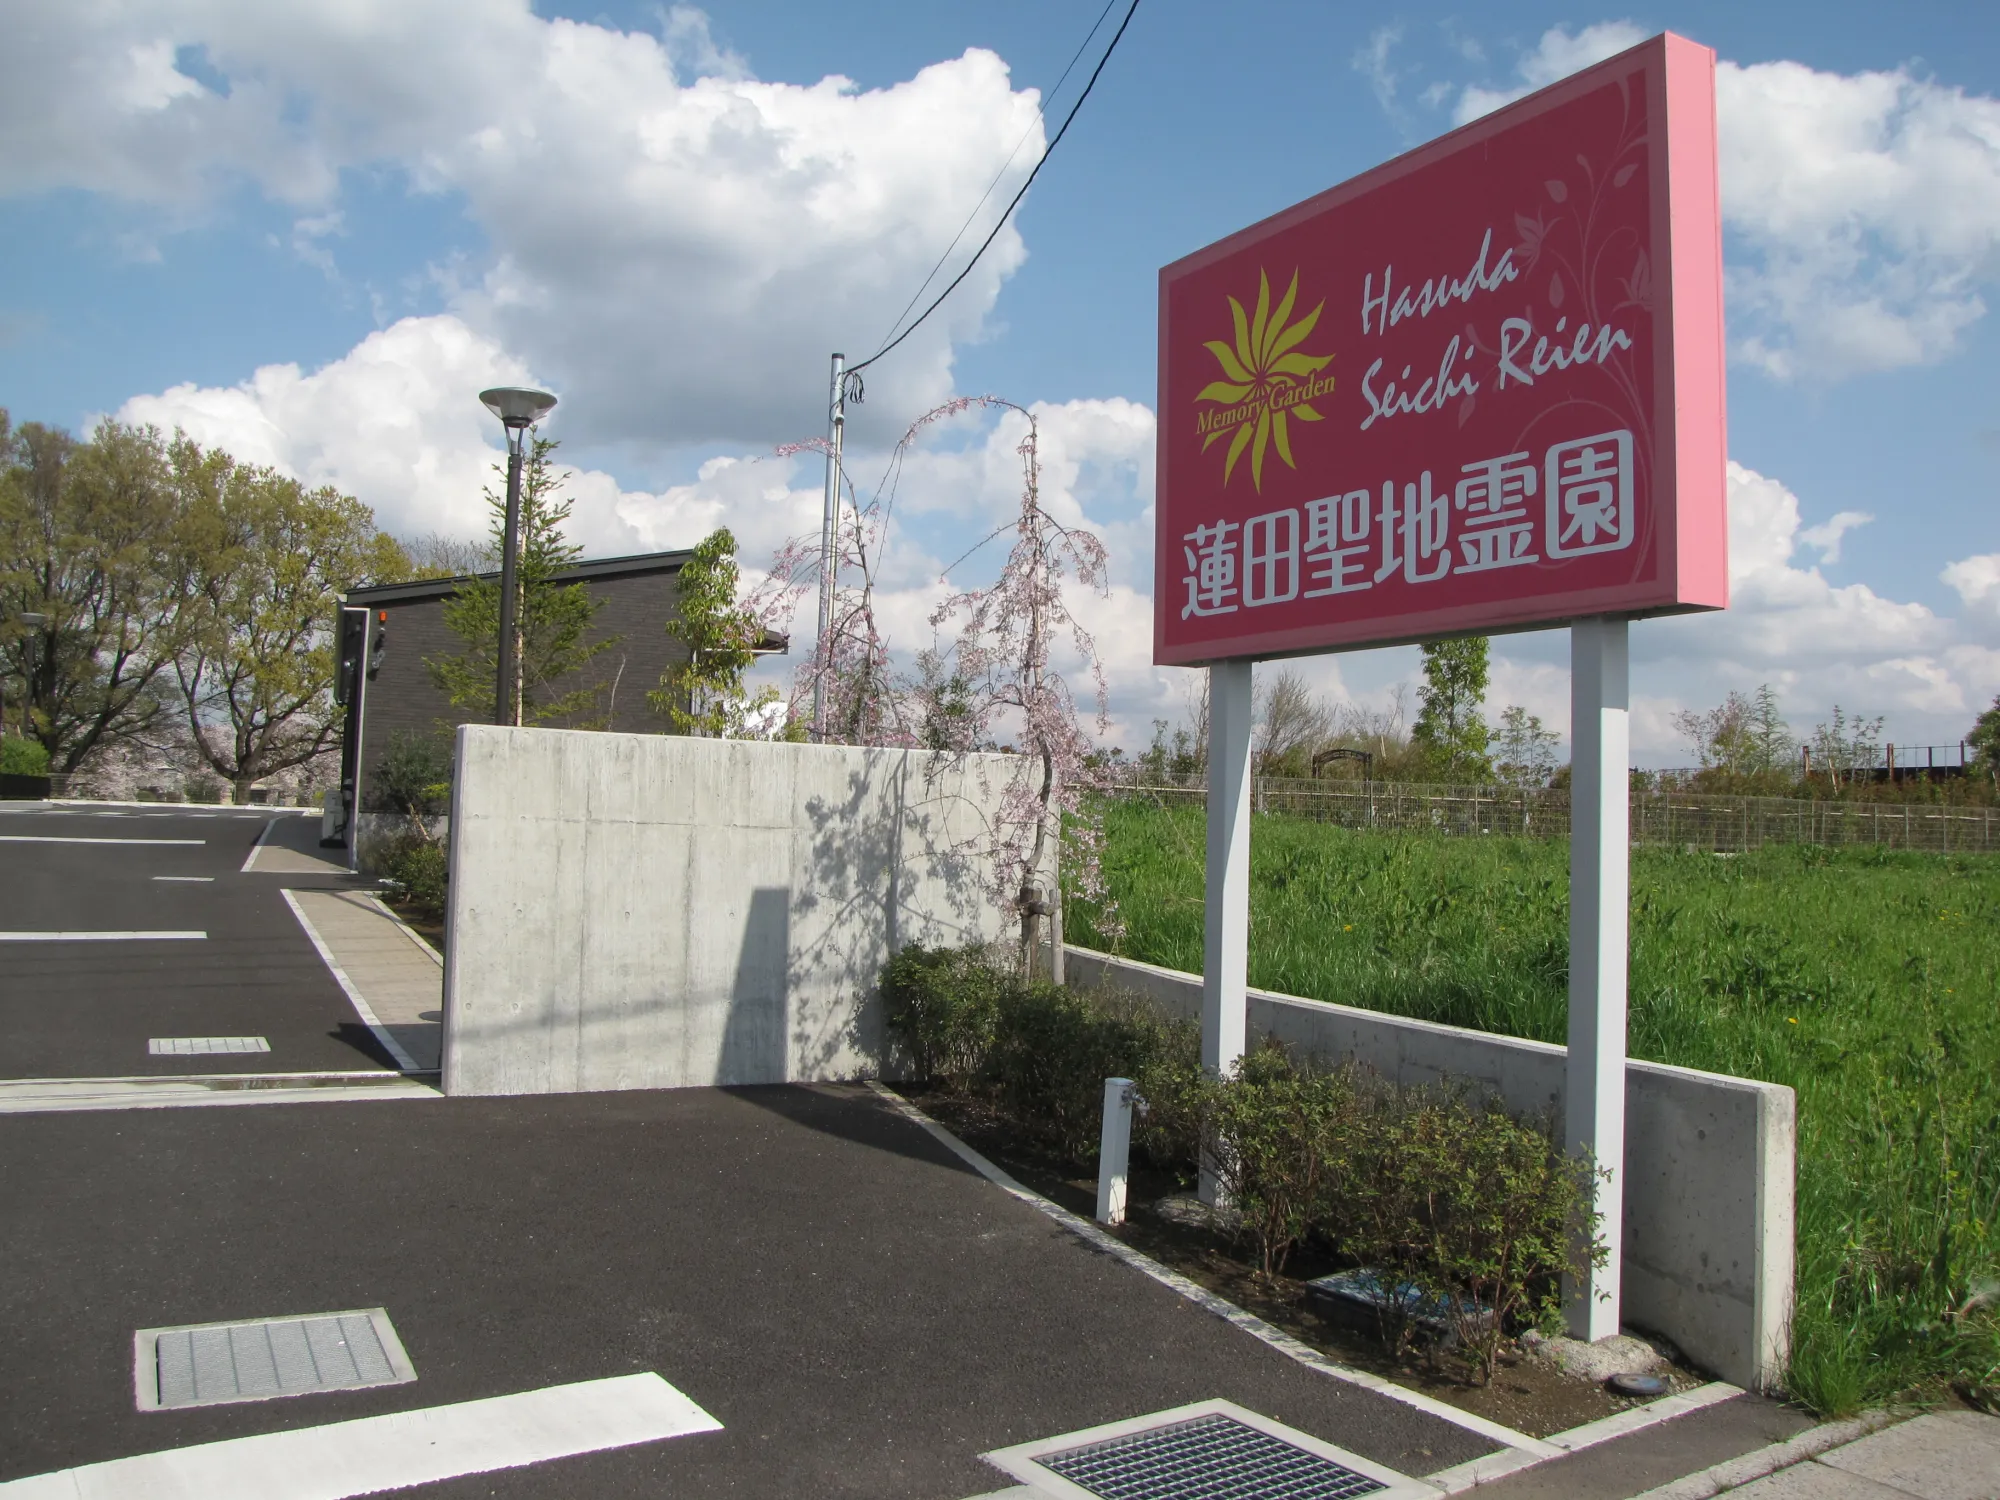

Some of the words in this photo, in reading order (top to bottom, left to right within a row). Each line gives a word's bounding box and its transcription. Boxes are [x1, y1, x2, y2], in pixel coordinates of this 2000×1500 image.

[1360, 228, 1519, 336] Hasuda
[1196, 399, 1266, 434] Memory
[1269, 371, 1335, 409] Garden
[1360, 335, 1479, 430] Seichi
[1498, 317, 1631, 390] Reien
[1181, 429, 1634, 620] 蓮田聖地霊園
